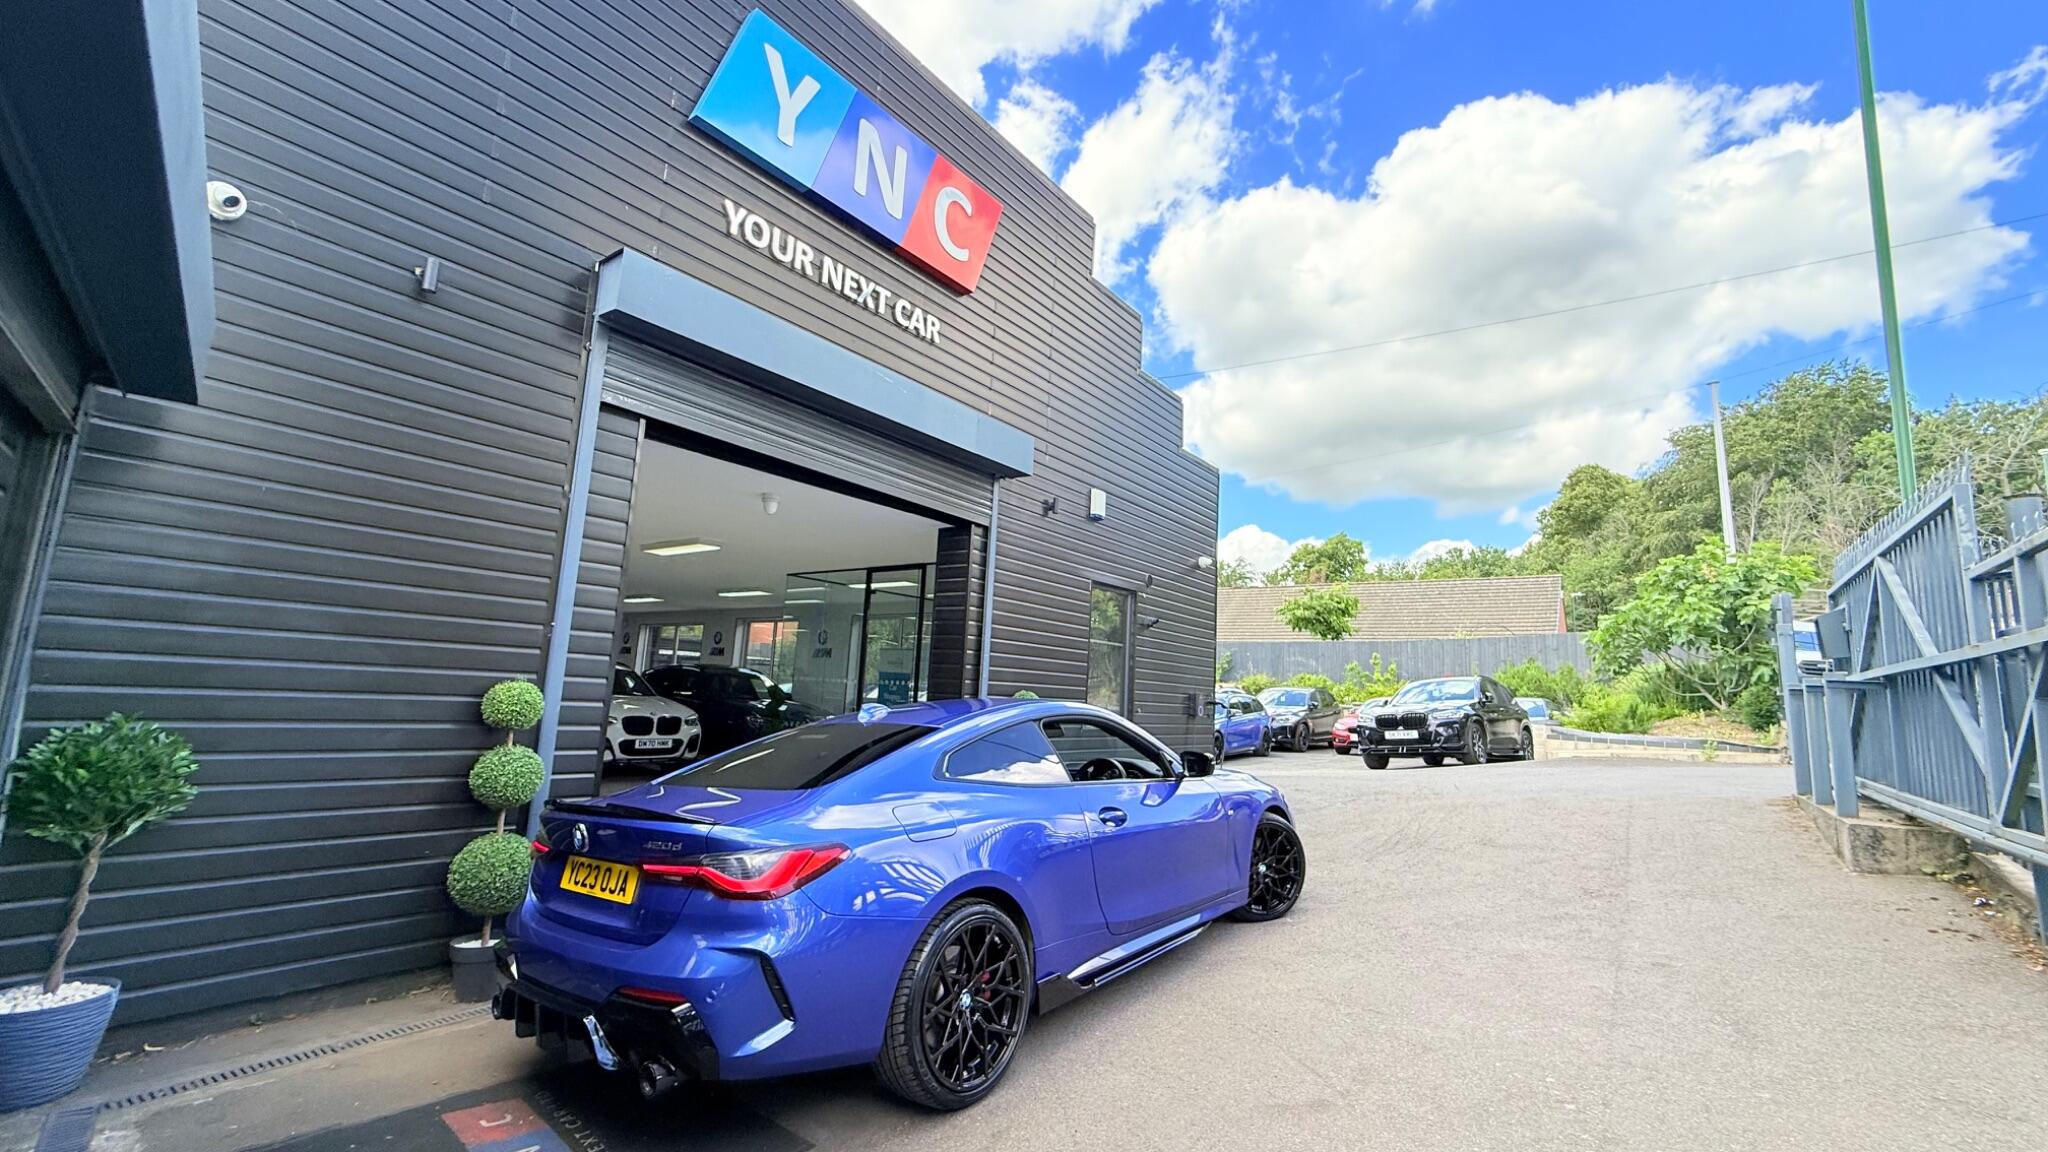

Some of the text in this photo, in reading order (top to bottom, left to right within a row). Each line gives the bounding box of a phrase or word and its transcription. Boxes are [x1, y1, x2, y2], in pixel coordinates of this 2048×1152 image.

[763, 42, 973, 262] YNC
[723, 199, 941, 343] YOUR NEXT CAR
[643, 841, 683, 851] 420d
[568, 859, 630, 897] YC23 OJA
[574, 1130, 607, 1152] EXT
